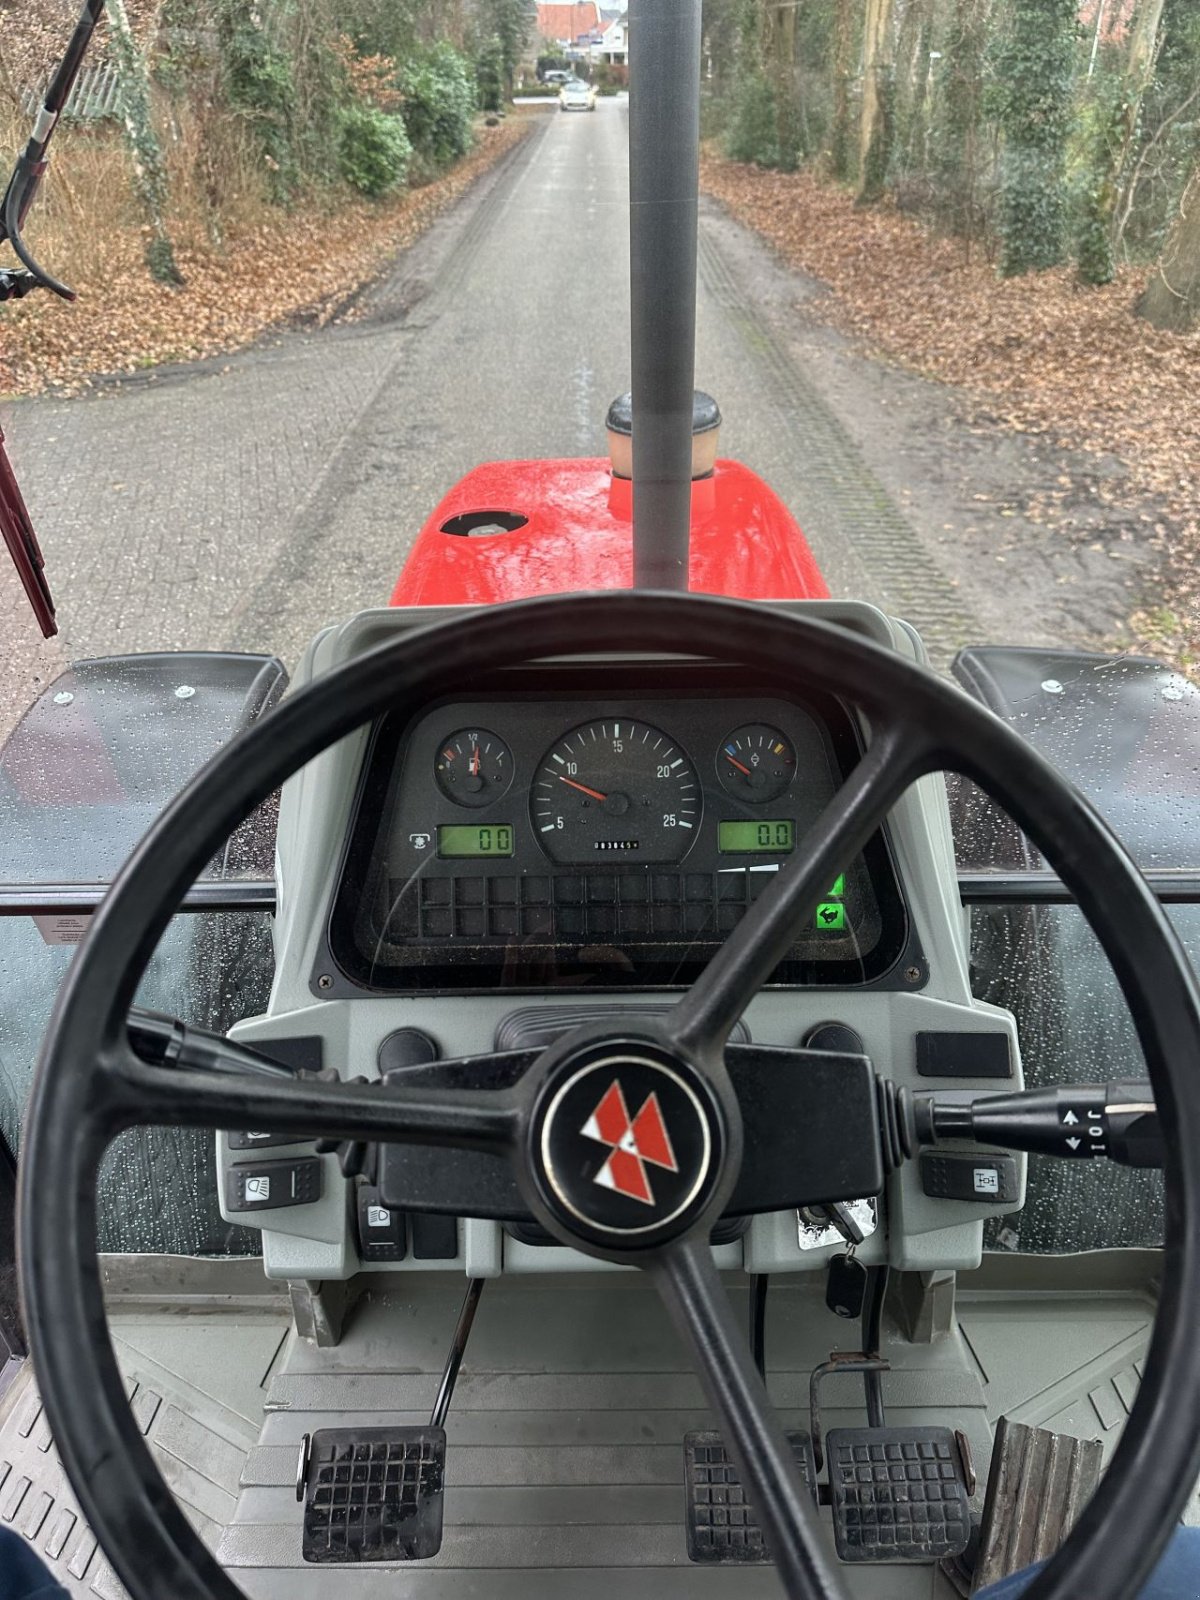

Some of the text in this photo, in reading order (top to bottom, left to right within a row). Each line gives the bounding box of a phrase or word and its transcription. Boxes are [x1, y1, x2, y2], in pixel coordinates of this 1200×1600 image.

[612, 740, 623, 753] 15
[567, 762, 577, 775] 10
[657, 766, 670, 778] 20
[557, 816, 564, 829] 5
[663, 814, 676, 827] 25
